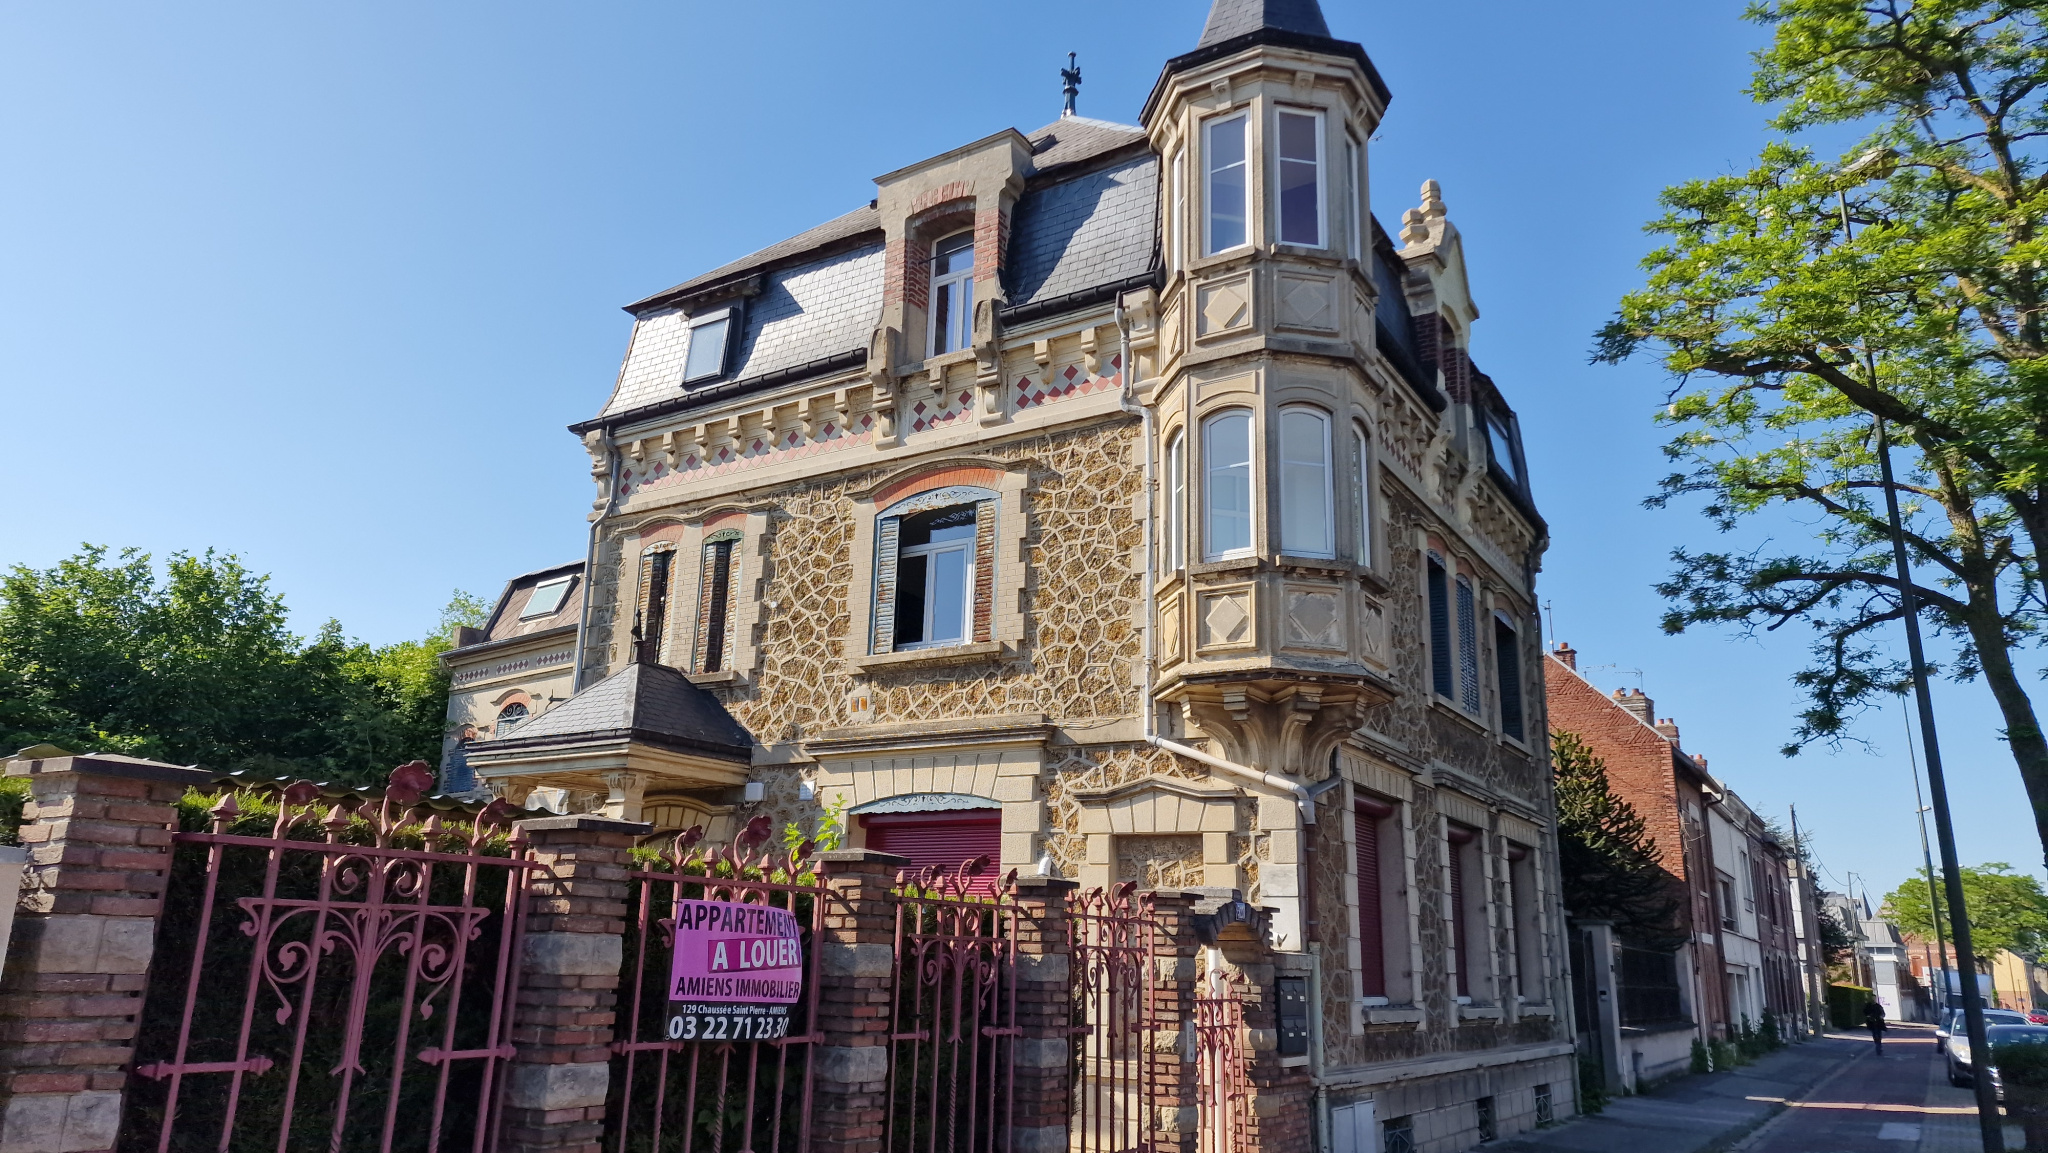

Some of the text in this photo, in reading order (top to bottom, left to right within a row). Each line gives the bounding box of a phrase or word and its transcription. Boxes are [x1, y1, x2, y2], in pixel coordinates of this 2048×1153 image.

[679, 904, 796, 938] APPARTEMENT
[712, 939, 798, 970] A LOUER
[675, 977, 800, 999] AMIENS IMMOBILIER
[682, 1004, 697, 1014] 129
[698, 1004, 731, 1015] Chaussée
[732, 1005, 748, 1015] Saint
[749, 1006, 766, 1015] Pierre
[769, 1006, 788, 1015] AMIENS
[669, 1016, 789, 1039] 03 22 71 23 30
